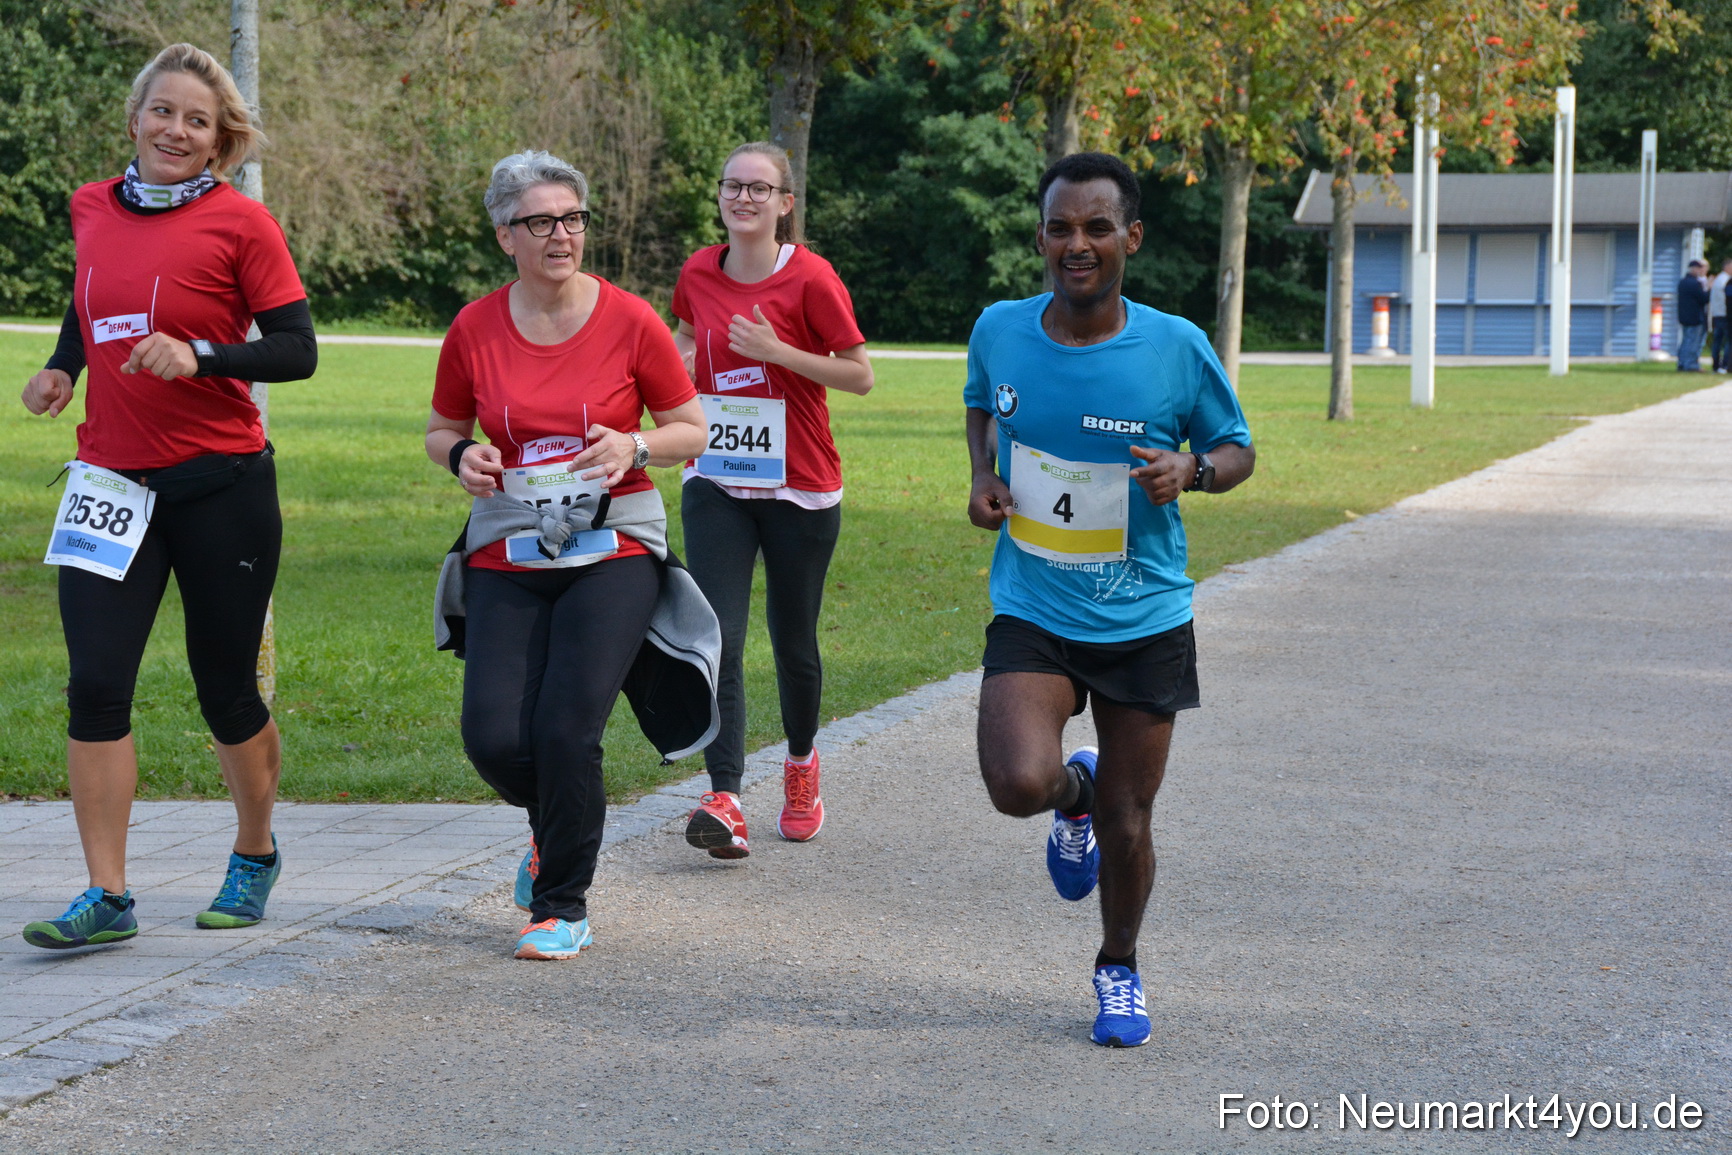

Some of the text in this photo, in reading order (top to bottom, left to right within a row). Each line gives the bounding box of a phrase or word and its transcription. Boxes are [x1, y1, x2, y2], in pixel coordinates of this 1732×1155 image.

[108, 321, 132, 334] DEHN
[727, 372, 751, 385] DEHN
[729, 404, 760, 415] BOCK
[1081, 414, 1147, 435] BOCK
[708, 423, 772, 453] 2544
[537, 440, 565, 455] DEHN
[723, 460, 757, 472] Paulina
[1051, 465, 1091, 481] BOCK
[93, 473, 127, 493] BOCK
[537, 472, 576, 485] BOCK
[63, 492, 134, 537] 2538
[1052, 492, 1074, 524] 4
[65, 535, 97, 553] Nadine
[563, 536, 579, 552] git
[1103, 573, 1126, 600] September
